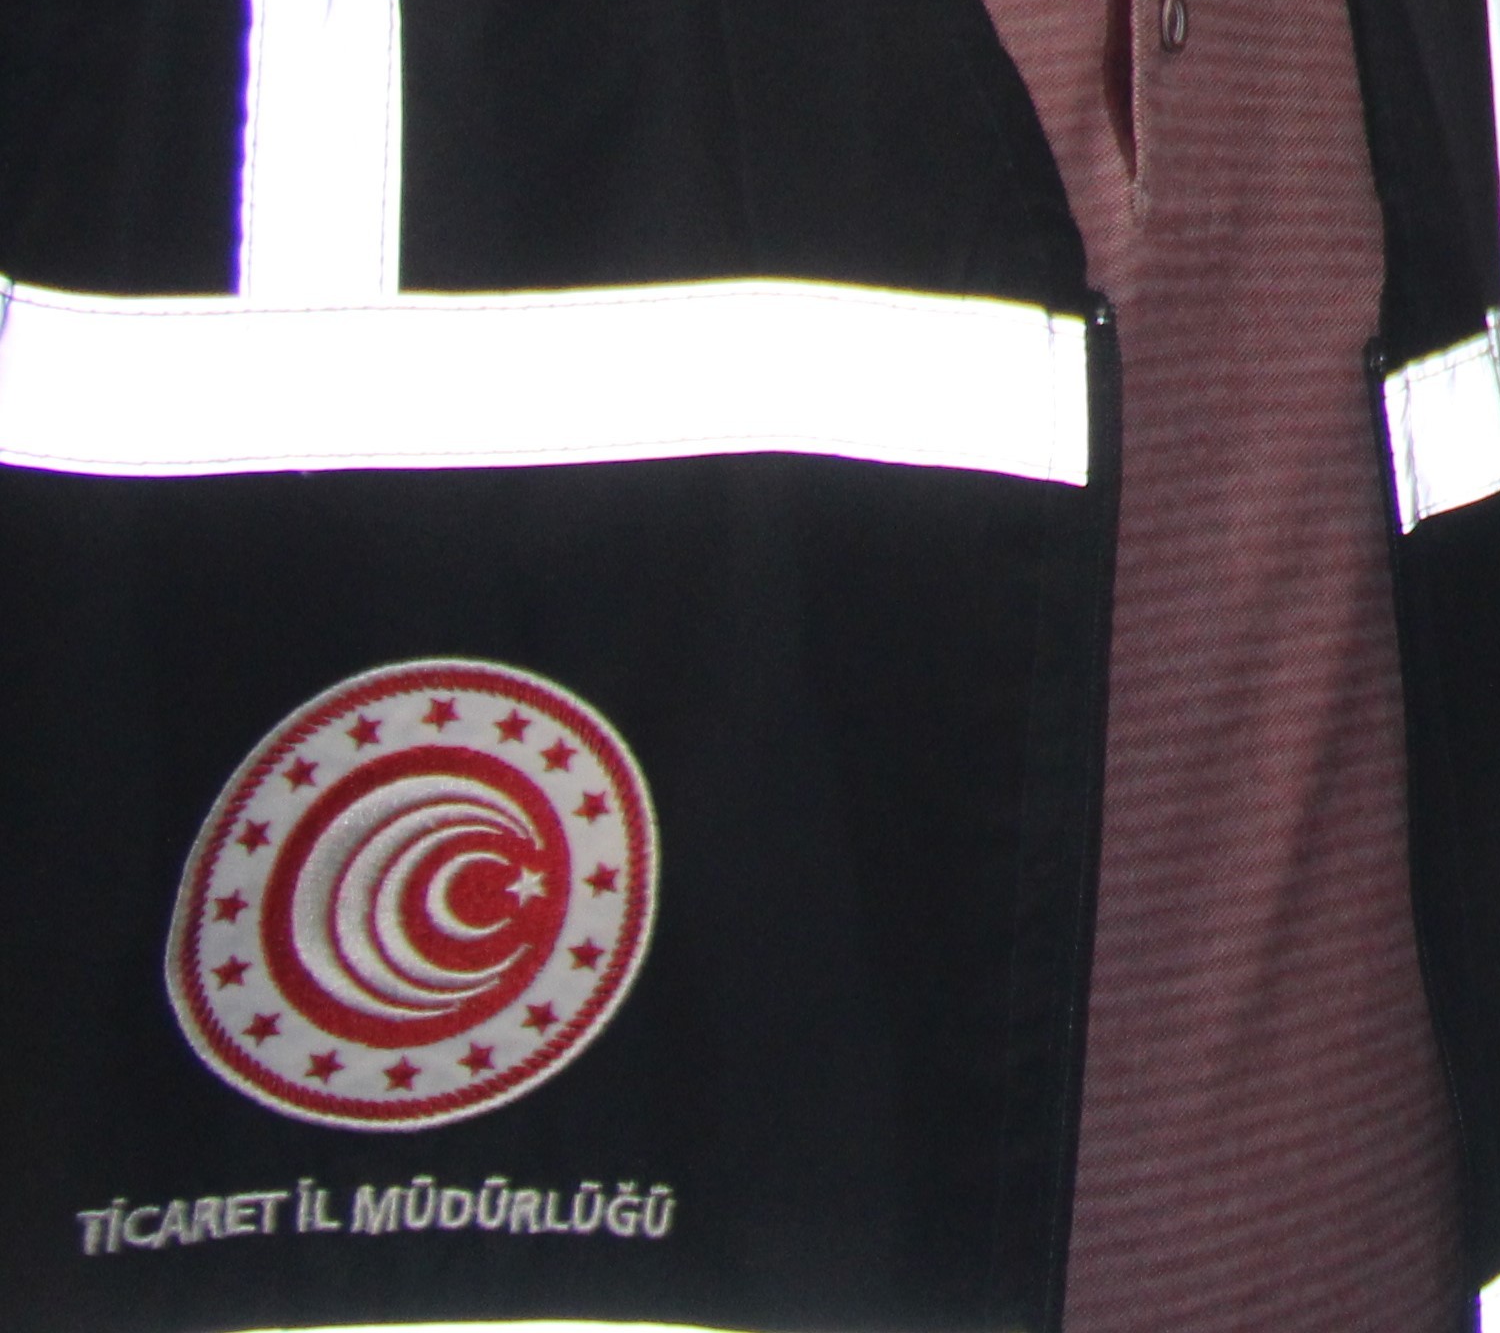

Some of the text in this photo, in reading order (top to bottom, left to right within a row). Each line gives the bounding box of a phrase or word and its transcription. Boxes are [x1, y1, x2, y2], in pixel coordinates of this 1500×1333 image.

[76, 1174, 676, 1256] TİCARET İL MÜDÜRLÜĞÜ
